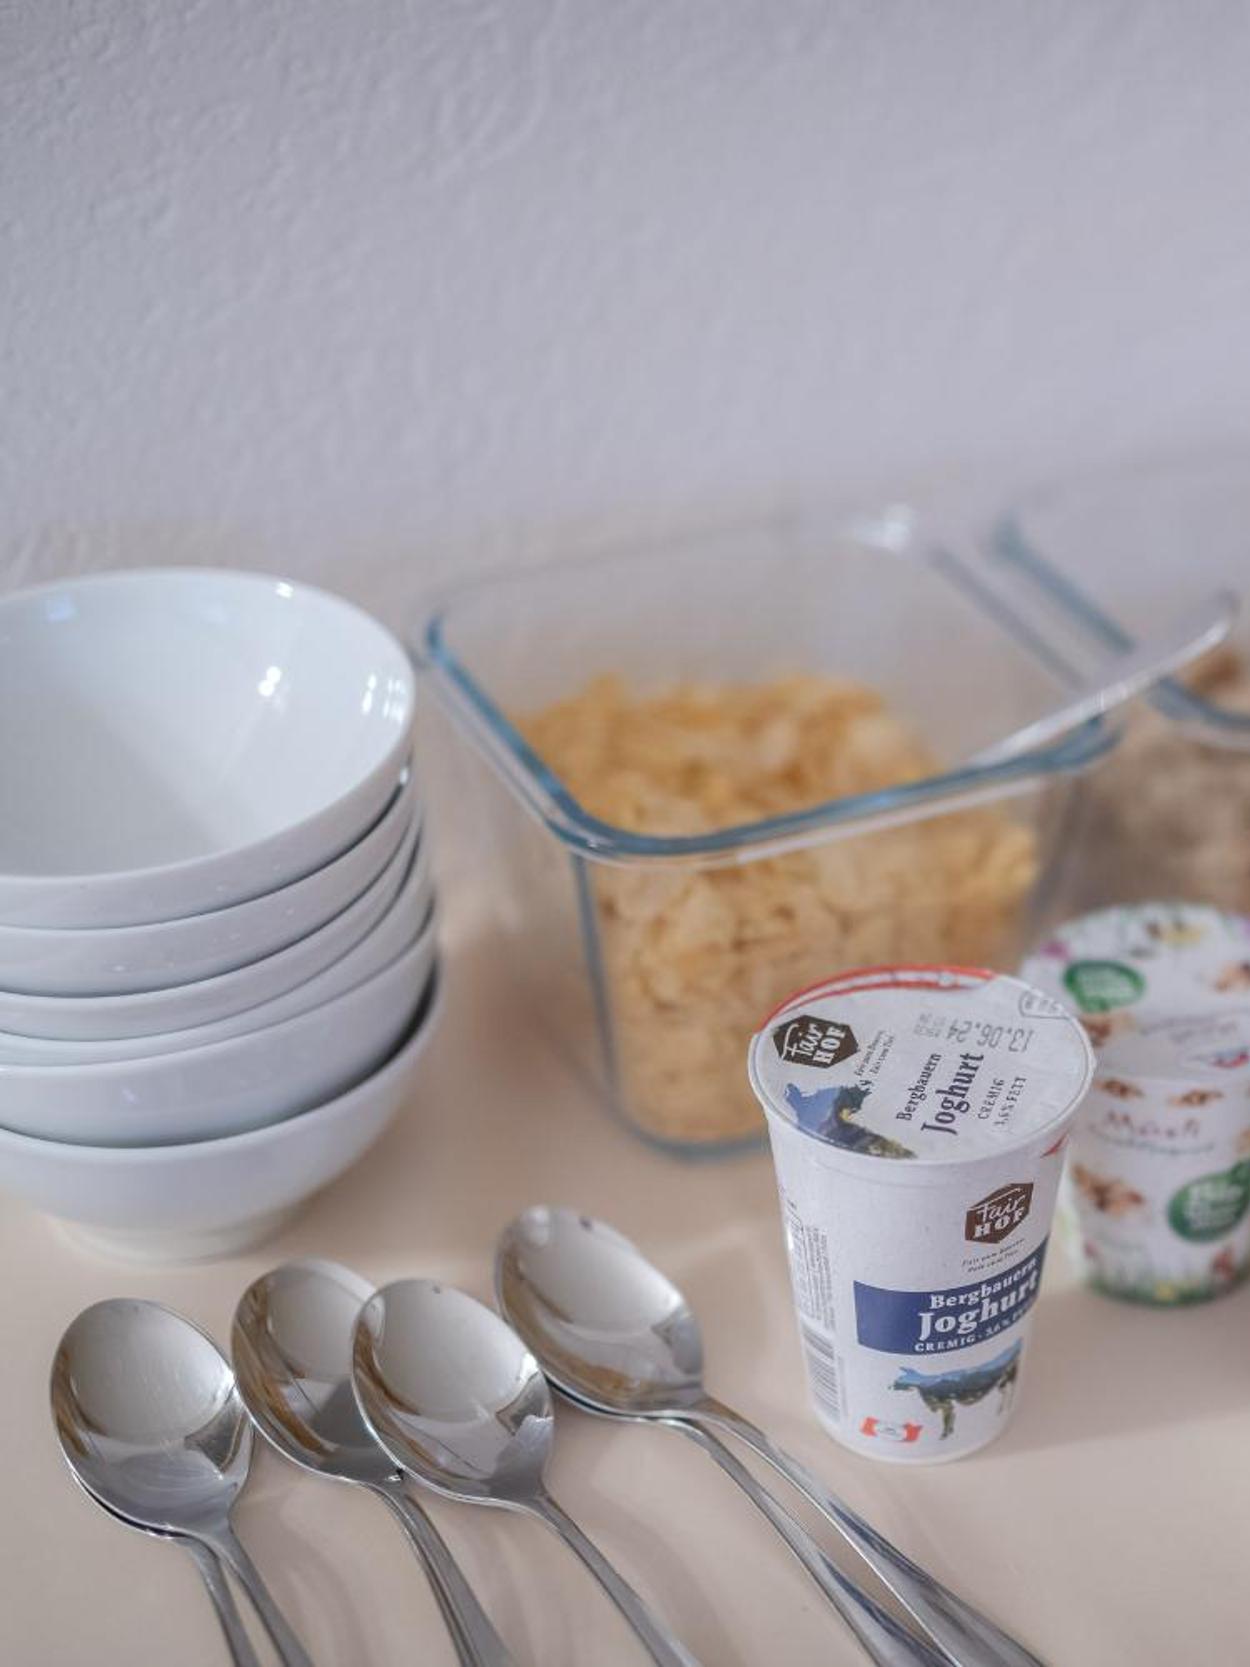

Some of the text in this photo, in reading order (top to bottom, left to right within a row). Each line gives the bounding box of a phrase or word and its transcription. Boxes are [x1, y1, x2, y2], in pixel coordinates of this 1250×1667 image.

[783, 1022, 827, 1061] Fair
[813, 1027, 848, 1067] HOF
[945, 1020, 1035, 1054] 13.06.24
[896, 1052, 942, 1121] Bergbauern
[921, 1051, 985, 1136] Joghurt
[977, 1077, 1005, 1120] CREMIG
[966, 1188, 1027, 1222] Fair
[973, 1207, 1025, 1239] HOF
[929, 1258, 1038, 1310] Bergbauern
[917, 1268, 1040, 1341] Joghurt
[914, 1334, 976, 1352] CREMIG
